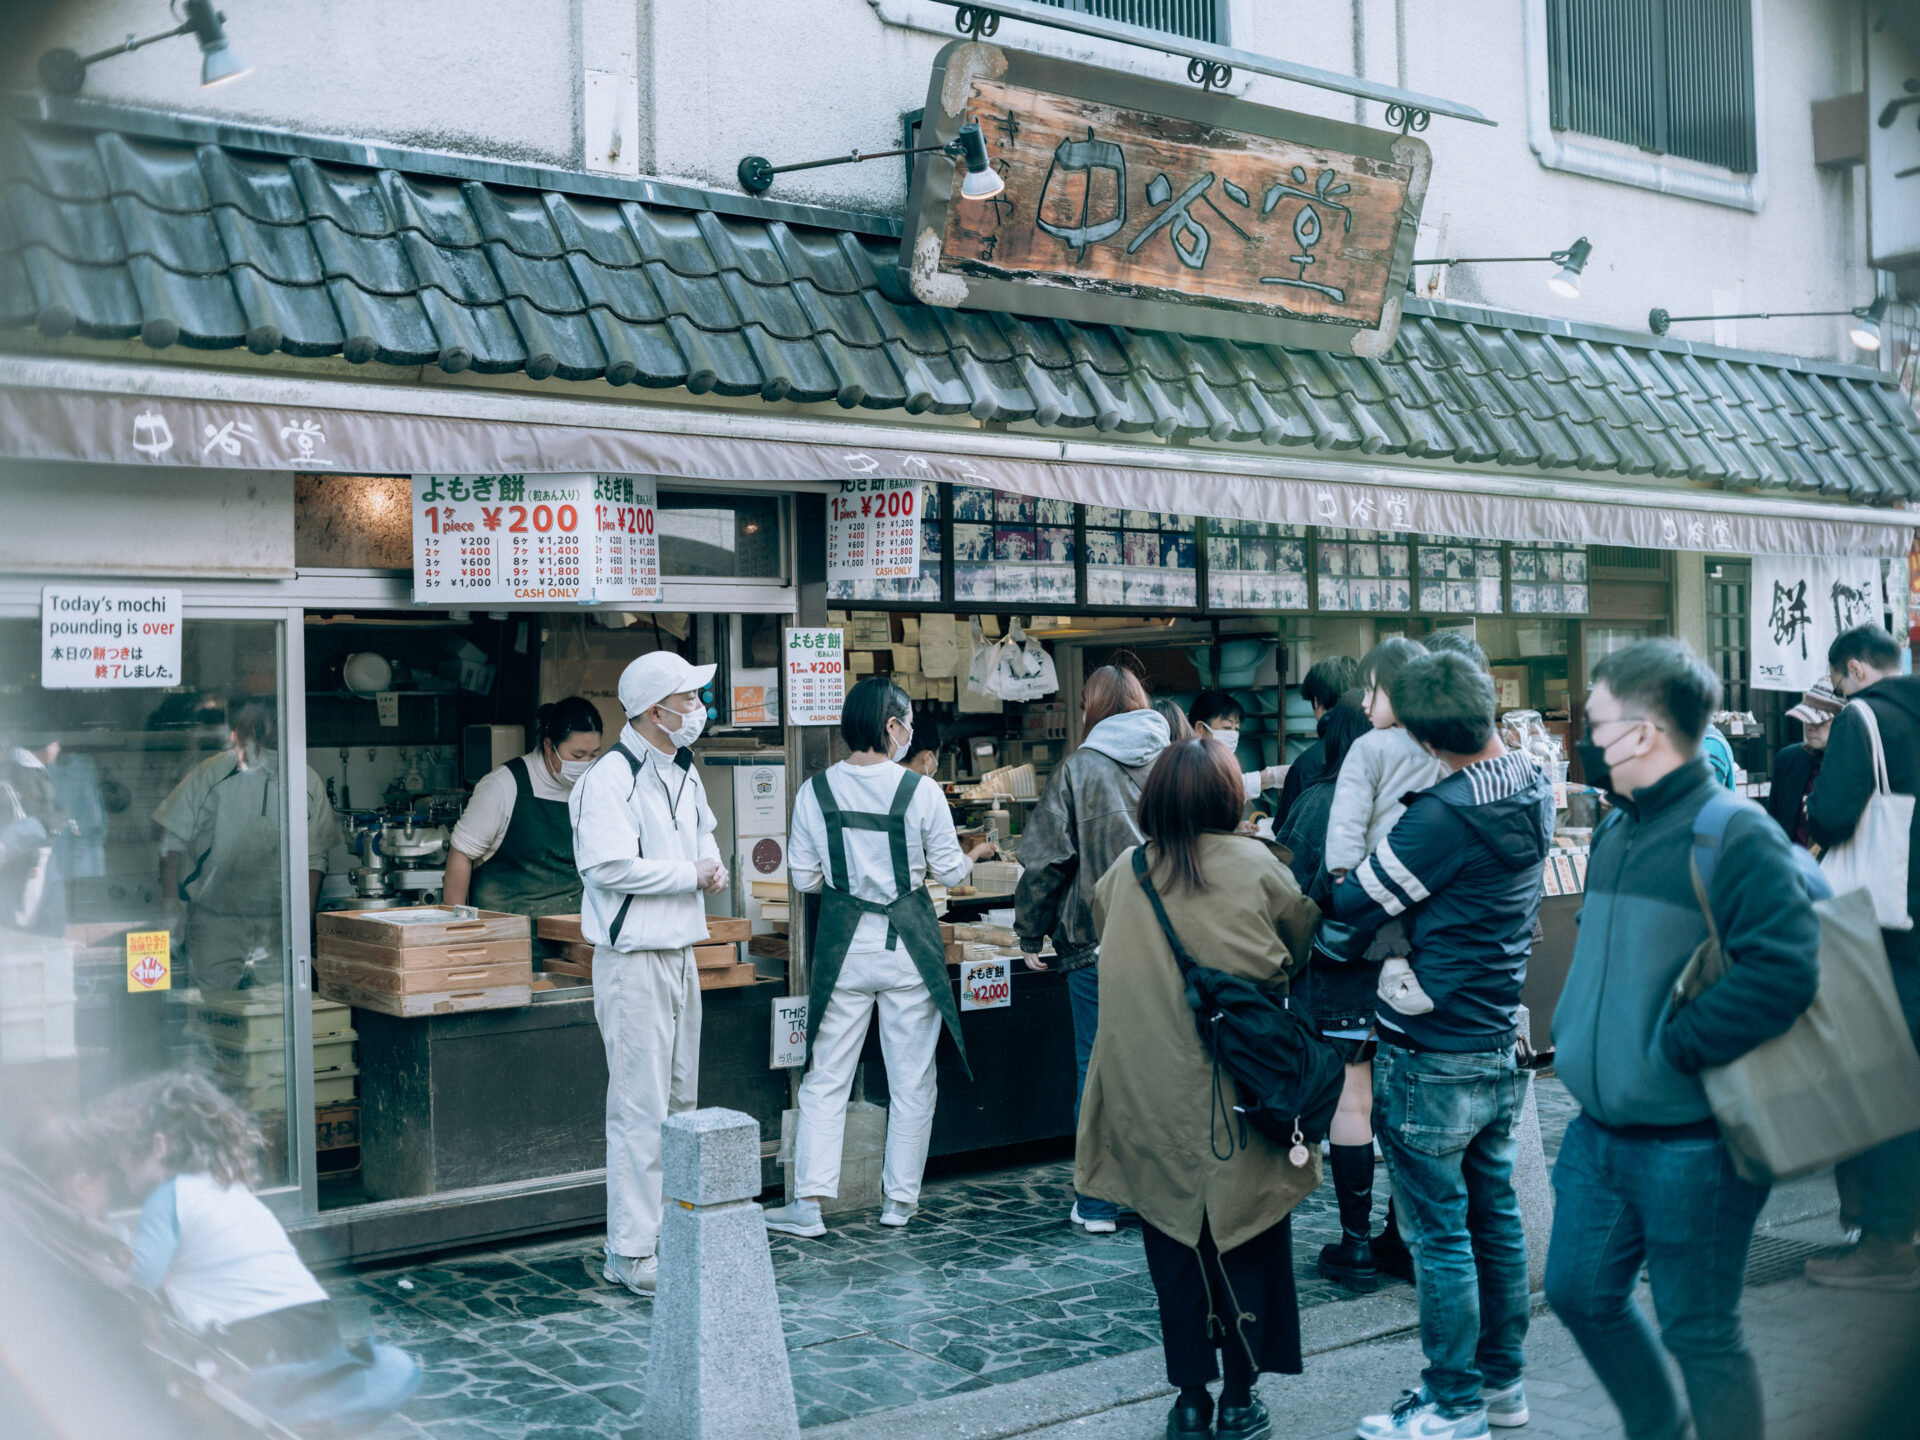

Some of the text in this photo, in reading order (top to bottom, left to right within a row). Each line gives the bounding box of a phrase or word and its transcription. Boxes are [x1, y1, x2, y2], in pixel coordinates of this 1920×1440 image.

[422, 474, 525, 502] よもぎ餅
[594, 475, 634, 504] よもぎ餅
[861, 491, 914, 518] ¥200
[443, 519, 475, 535] piece
[481, 504, 578, 533] ¥200
[617, 506, 654, 535] ¥200
[461, 537, 490, 546] ¥200
[538, 536, 579, 545] ¥1,200
[461, 547, 490, 556] ¥400
[538, 546, 579, 556] ¥1,400
[461, 557, 491, 566] ¥600
[539, 556, 579, 566] ¥1,600
[461, 568, 491, 576] ¥800
[539, 567, 580, 576] ¥1,800
[875, 566, 912, 576] CASH ONLY
[451, 578, 491, 588] ¥1,000
[539, 577, 580, 587] ¥2,000
[514, 588, 579, 598] CASH ONLY
[50, 595, 166, 615] Today's mochi
[50, 619, 175, 637] pounding is over
[789, 633, 841, 649] よもぎ餅
[51, 646, 143, 661] 本日の餅つきは
[94, 664, 173, 679] 終了しました。
[810, 662, 842, 674] ¥200
[967, 965, 1005, 980] よもぎ餅
[974, 983, 1009, 1000] ¥2,000
[779, 1006, 806, 1019] THIS
[788, 1020, 808, 1031] TR
